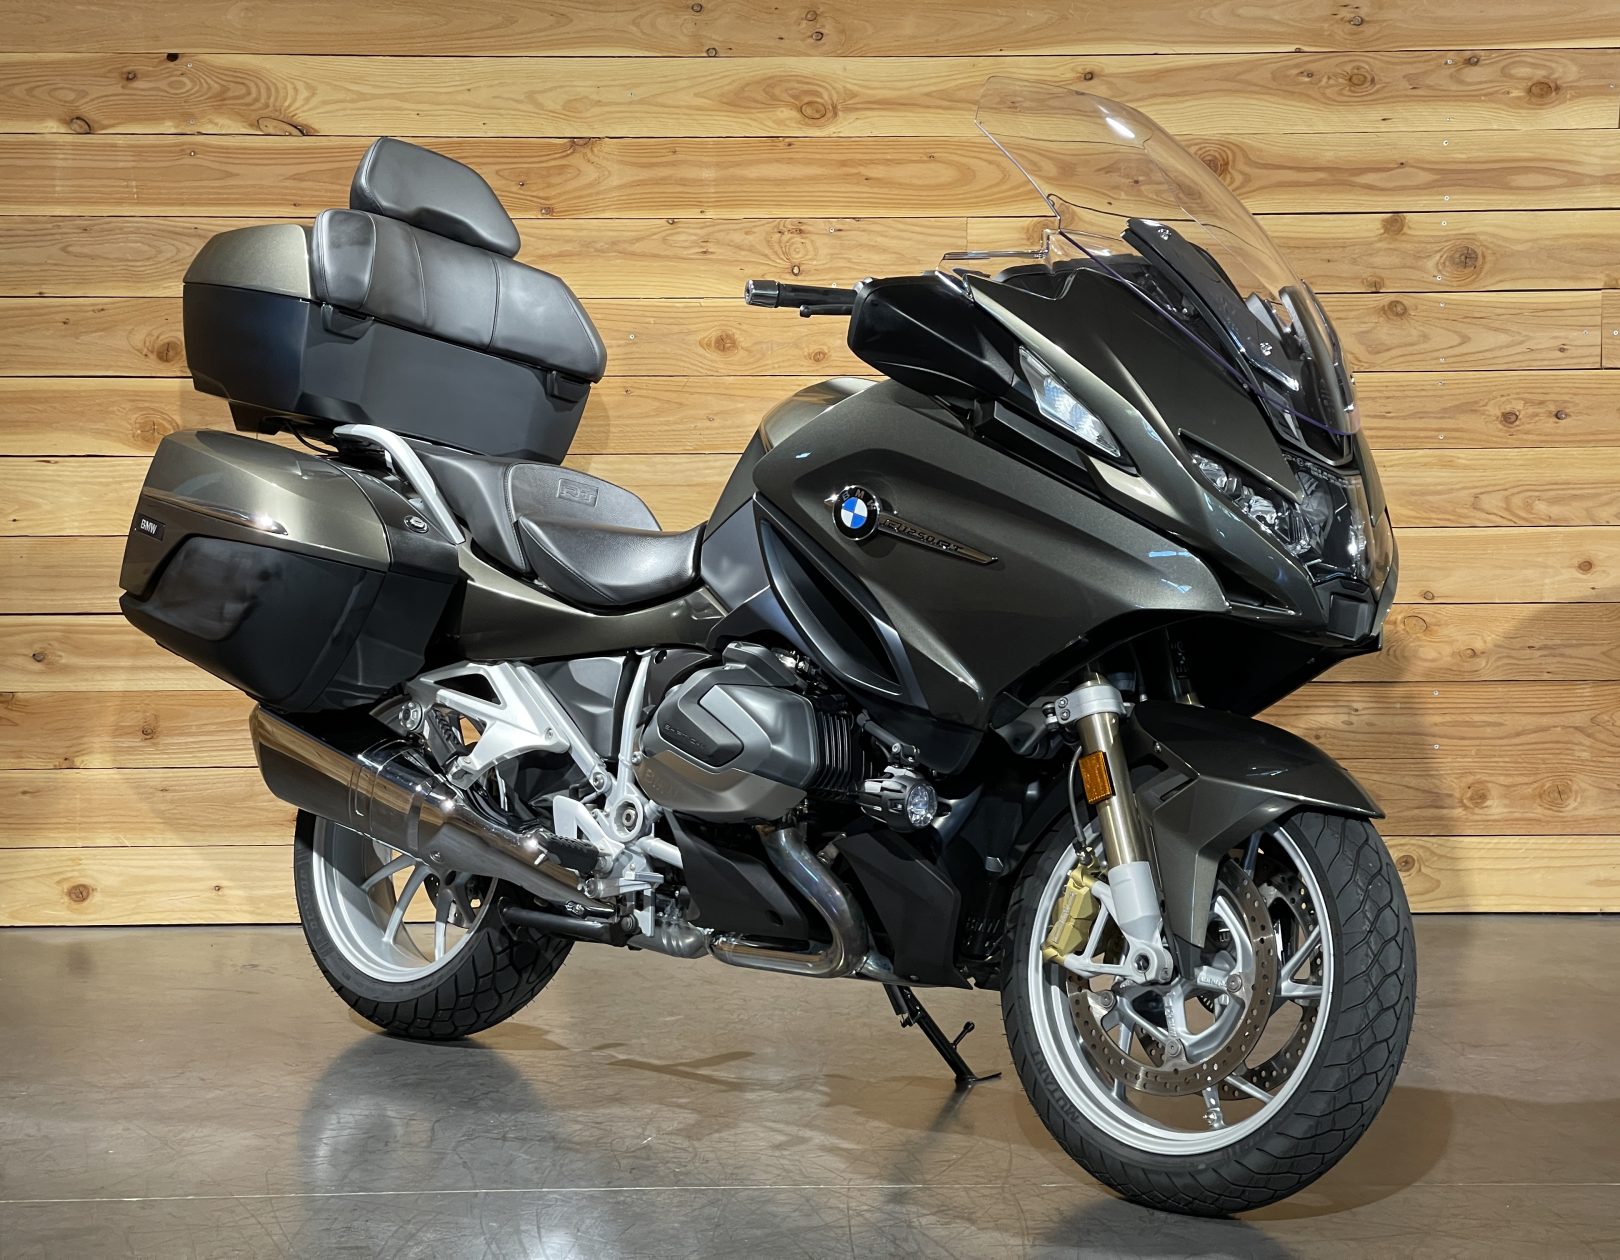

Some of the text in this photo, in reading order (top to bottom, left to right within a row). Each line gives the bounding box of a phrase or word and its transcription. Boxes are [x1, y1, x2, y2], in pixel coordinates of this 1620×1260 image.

[842, 488, 877, 511] BMW
[140, 518, 158, 535] BMW
[1030, 1049, 1081, 1124] MUTANT
